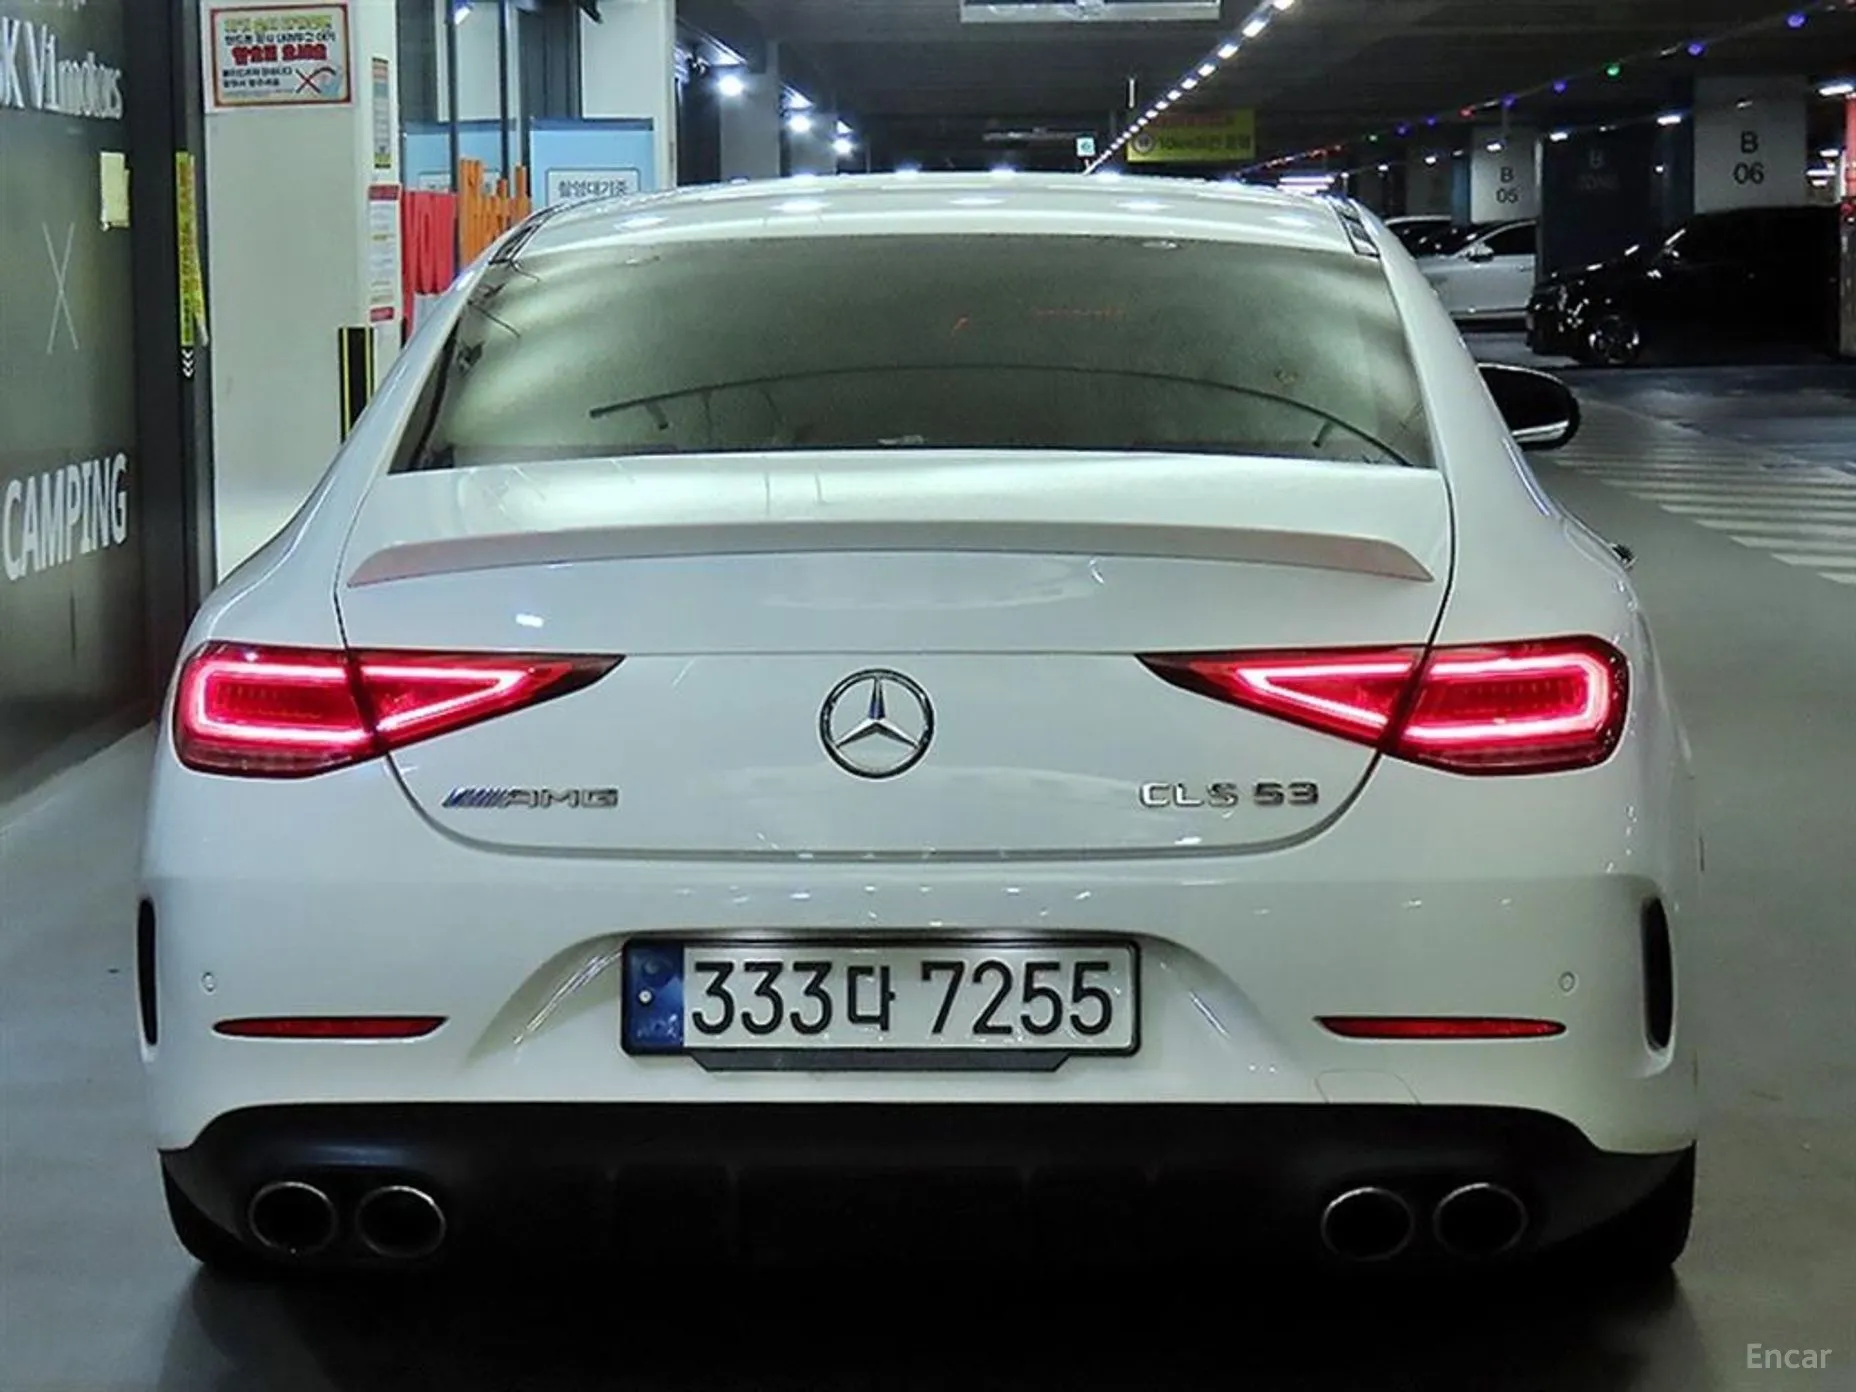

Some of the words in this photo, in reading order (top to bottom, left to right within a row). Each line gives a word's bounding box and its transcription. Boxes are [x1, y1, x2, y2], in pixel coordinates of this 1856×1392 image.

[1741, 131, 1759, 154] B
[1501, 167, 1514, 183] B
[1733, 162, 1764, 185] 06
[1496, 188, 1518, 204] 05
[3, 452, 127, 580] CAMPING
[504, 788, 618, 808] AMG
[1139, 782, 1239, 808] CLS
[1253, 781, 1319, 806] 53
[691, 959, 896, 1036] 333다
[920, 959, 1113, 1036] 7255
